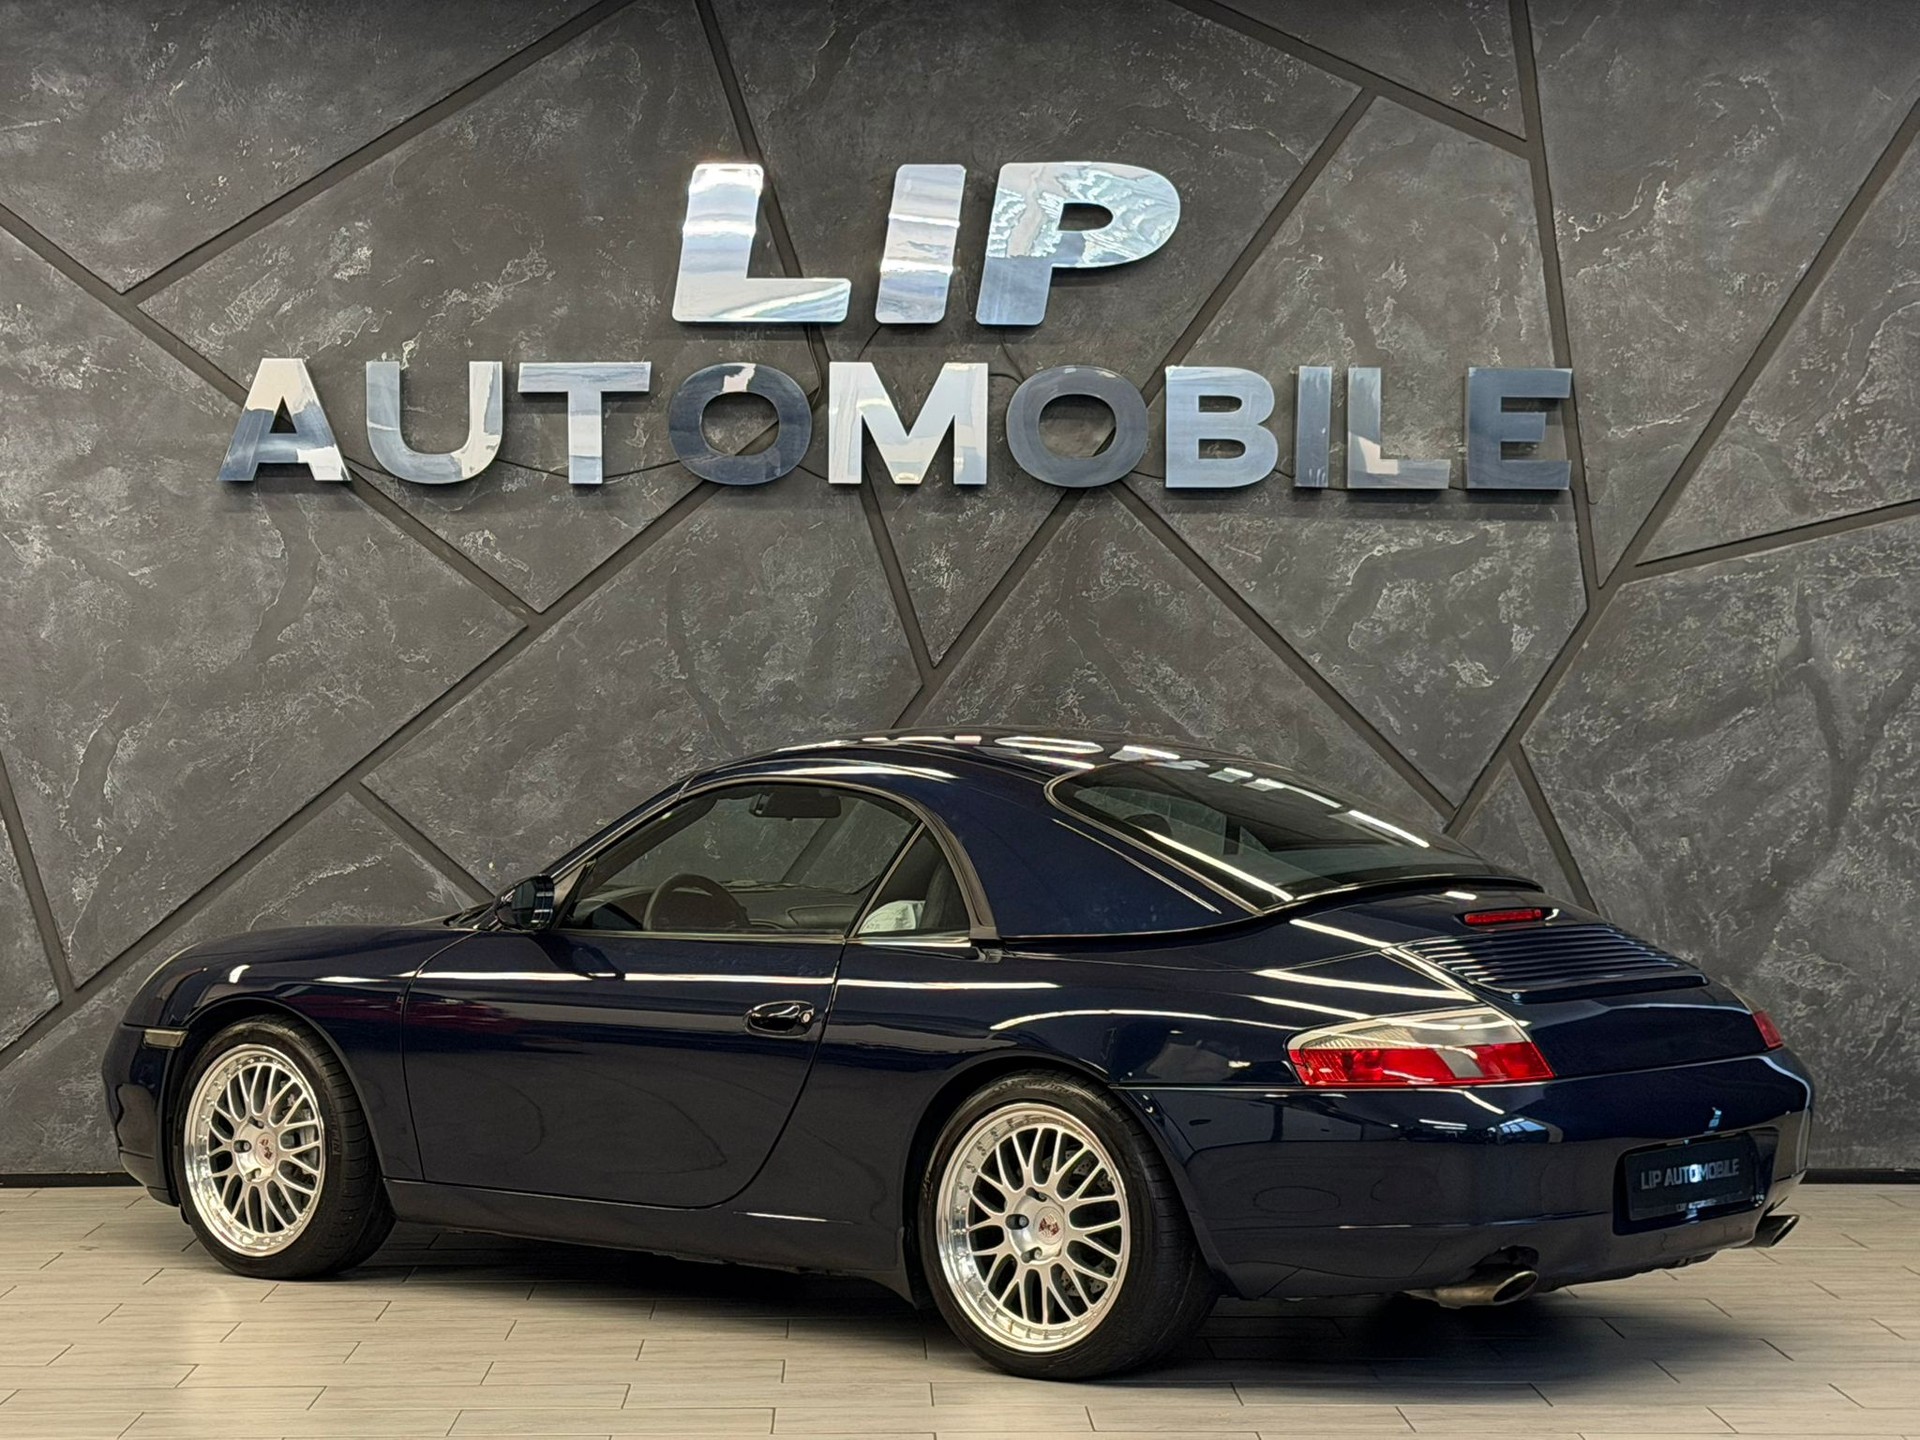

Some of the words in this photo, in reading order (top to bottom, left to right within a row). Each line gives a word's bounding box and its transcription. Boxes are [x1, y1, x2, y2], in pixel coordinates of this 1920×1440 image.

[671, 161, 1181, 326] LIP
[217, 357, 1573, 491] AUTOMOBILE
[1641, 1170, 1661, 1189] LIP
[1665, 1159, 1739, 1186] AUTOMOBILE
